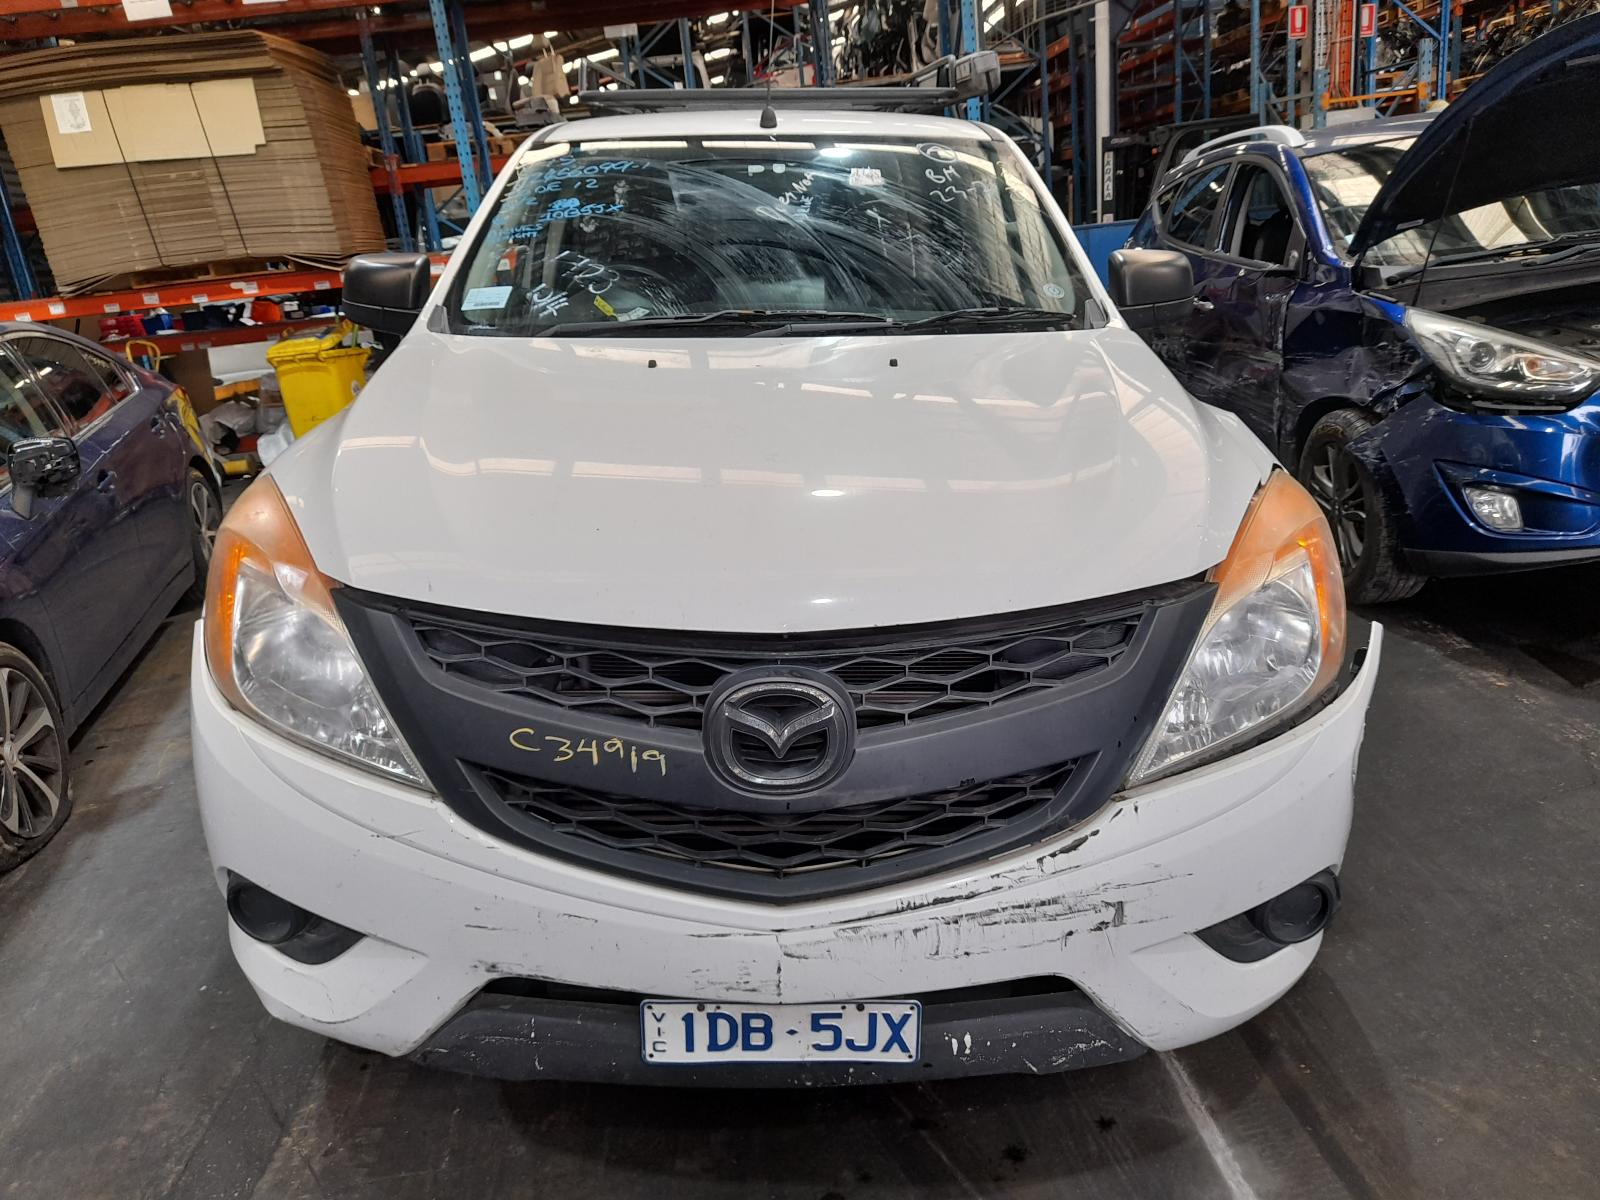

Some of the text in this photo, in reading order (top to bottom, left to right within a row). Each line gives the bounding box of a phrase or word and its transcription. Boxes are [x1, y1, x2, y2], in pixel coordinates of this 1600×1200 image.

[509, 727, 667, 777] C34919
[681, 1012, 913, 1053] 1DB 5JX
